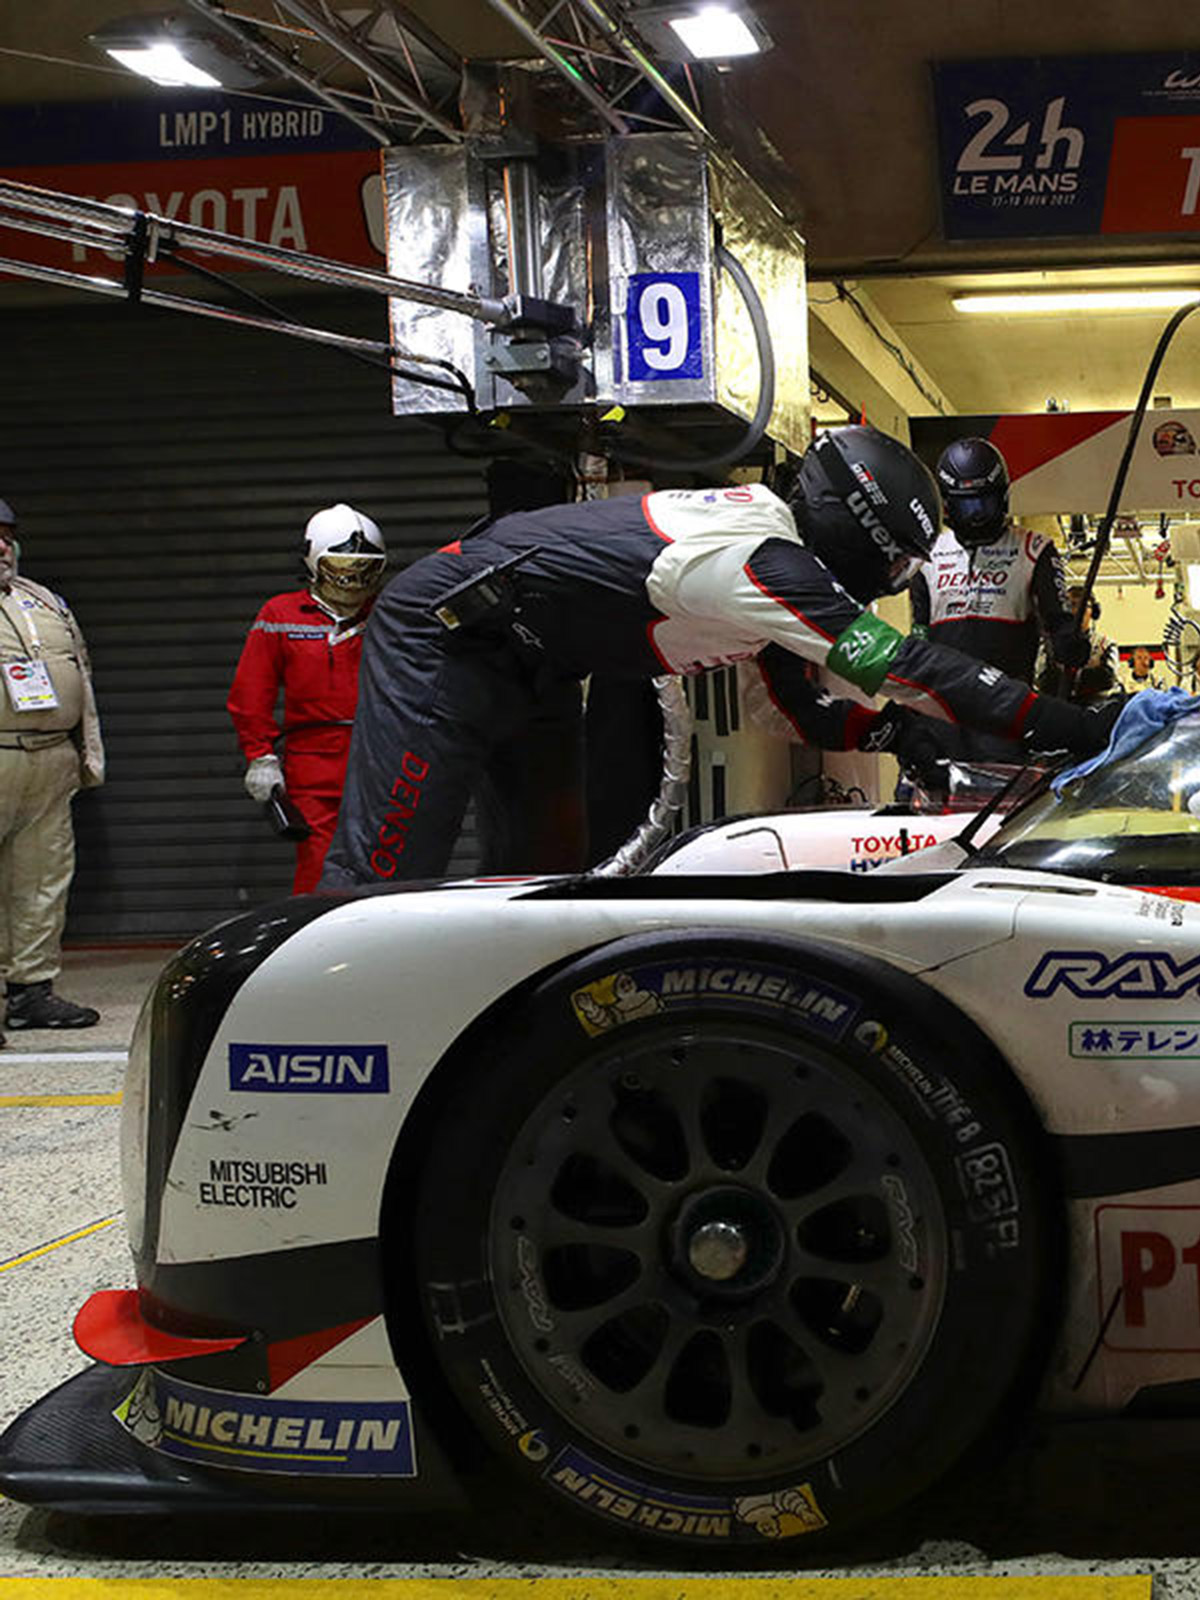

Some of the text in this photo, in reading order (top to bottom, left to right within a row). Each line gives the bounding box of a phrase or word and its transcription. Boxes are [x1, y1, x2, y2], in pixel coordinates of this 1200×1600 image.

[159, 110, 323, 147] LMP1 HYBRID
[956, 97, 1085, 172] 24h
[953, 173, 1078, 195] LE MANS
[639, 282, 688, 371] 9
[847, 489, 902, 562] uvex
[937, 570, 1008, 589] DENSO
[370, 751, 430, 879] DENSO
[851, 834, 937, 854] TOYOTA
[662, 968, 848, 1023] MICHELIN
[241, 1053, 375, 1085] AISIN
[200, 1183, 298, 1208] ELECTRIC
[210, 1160, 328, 1185] MITSUBISHI
[166, 1396, 401, 1451] MICHELIN
[553, 1466, 731, 1537] MICHELIN
